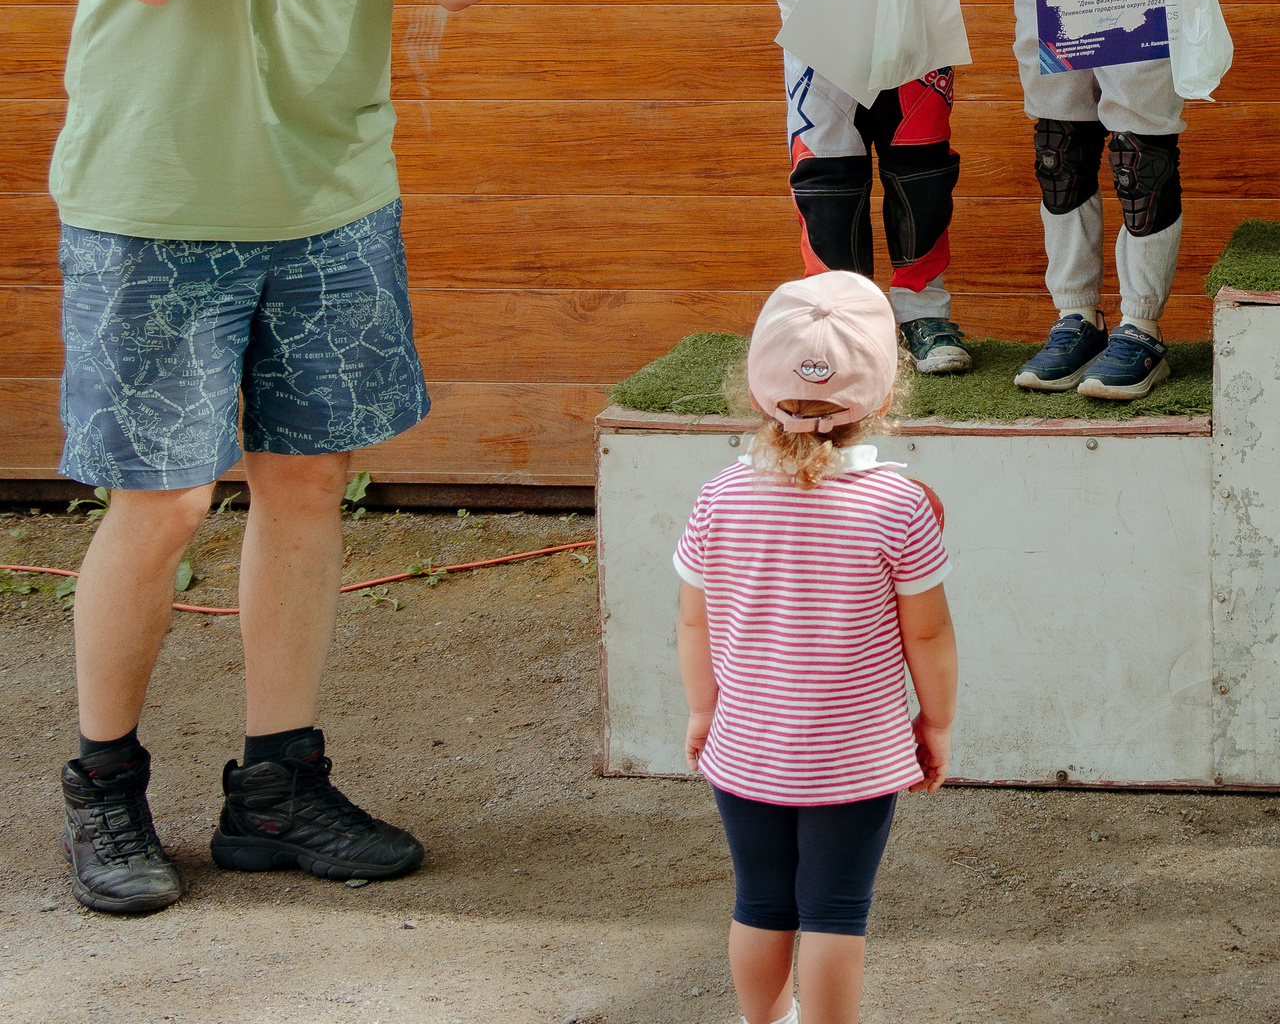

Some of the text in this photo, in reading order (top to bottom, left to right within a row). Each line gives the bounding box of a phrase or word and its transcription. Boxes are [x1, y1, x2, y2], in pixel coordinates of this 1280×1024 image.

[1061, 7, 1093, 17] Ленинском
[1094, 4, 1126, 15] городском
[1127, 1, 1146, 12] округе
[1147, 0, 1161, 7] 2024
[1078, 0, 1095, 8] "День
[921, 69, 953, 103] edb
